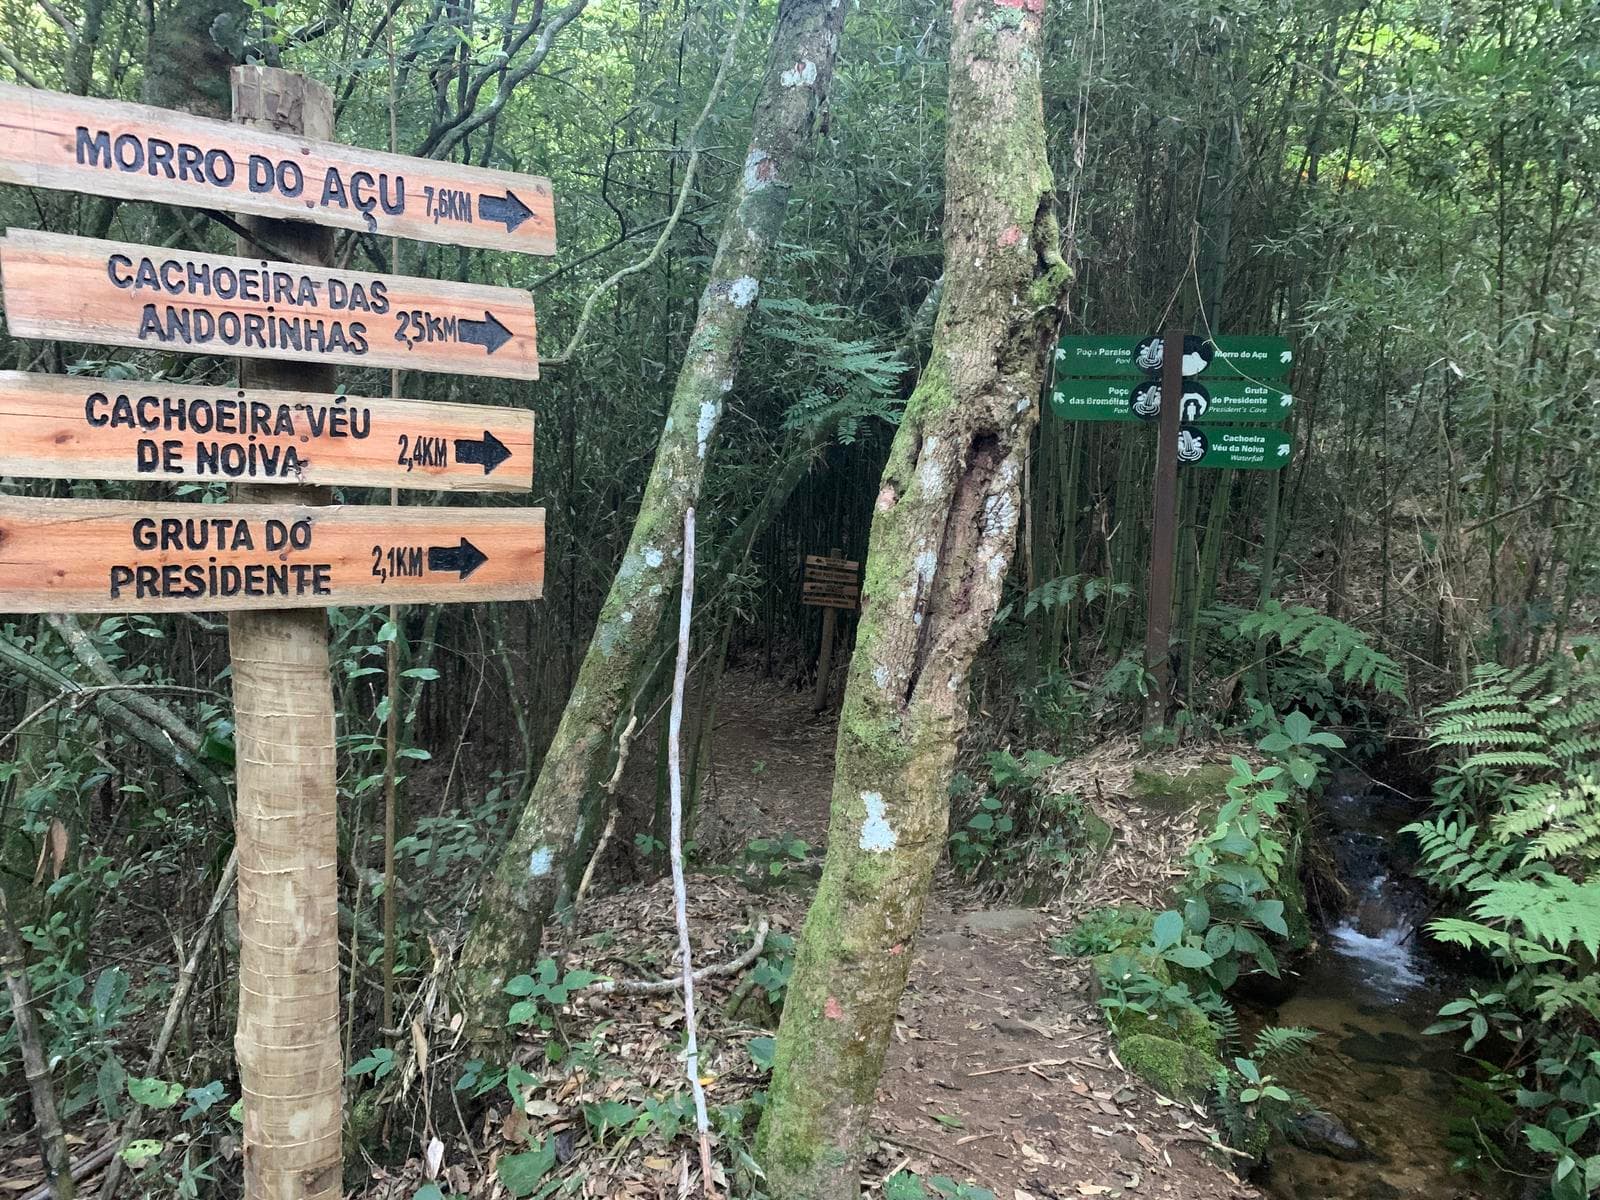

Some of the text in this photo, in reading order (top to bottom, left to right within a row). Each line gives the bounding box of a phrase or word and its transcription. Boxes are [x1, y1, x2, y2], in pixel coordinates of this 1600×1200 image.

[76, 126, 235, 187] MORRO
[249, 155, 304, 198] DO
[320, 167, 405, 232] AÇU
[328, 278, 390, 314] DAS
[1214, 350, 1268, 360] Morro do Açu
[1108, 386, 1129, 396] Poço
[1069, 397, 1085, 405] das
[1211, 396, 1268, 404] do Presidente
[305, 396, 371, 439] VÉU
[1223, 434, 1265, 443] Cachoeira
[1212, 443, 1265, 453] Véu da Noiva
[137, 439, 184, 474] DE
[132, 517, 312, 551] GRUTA DO
